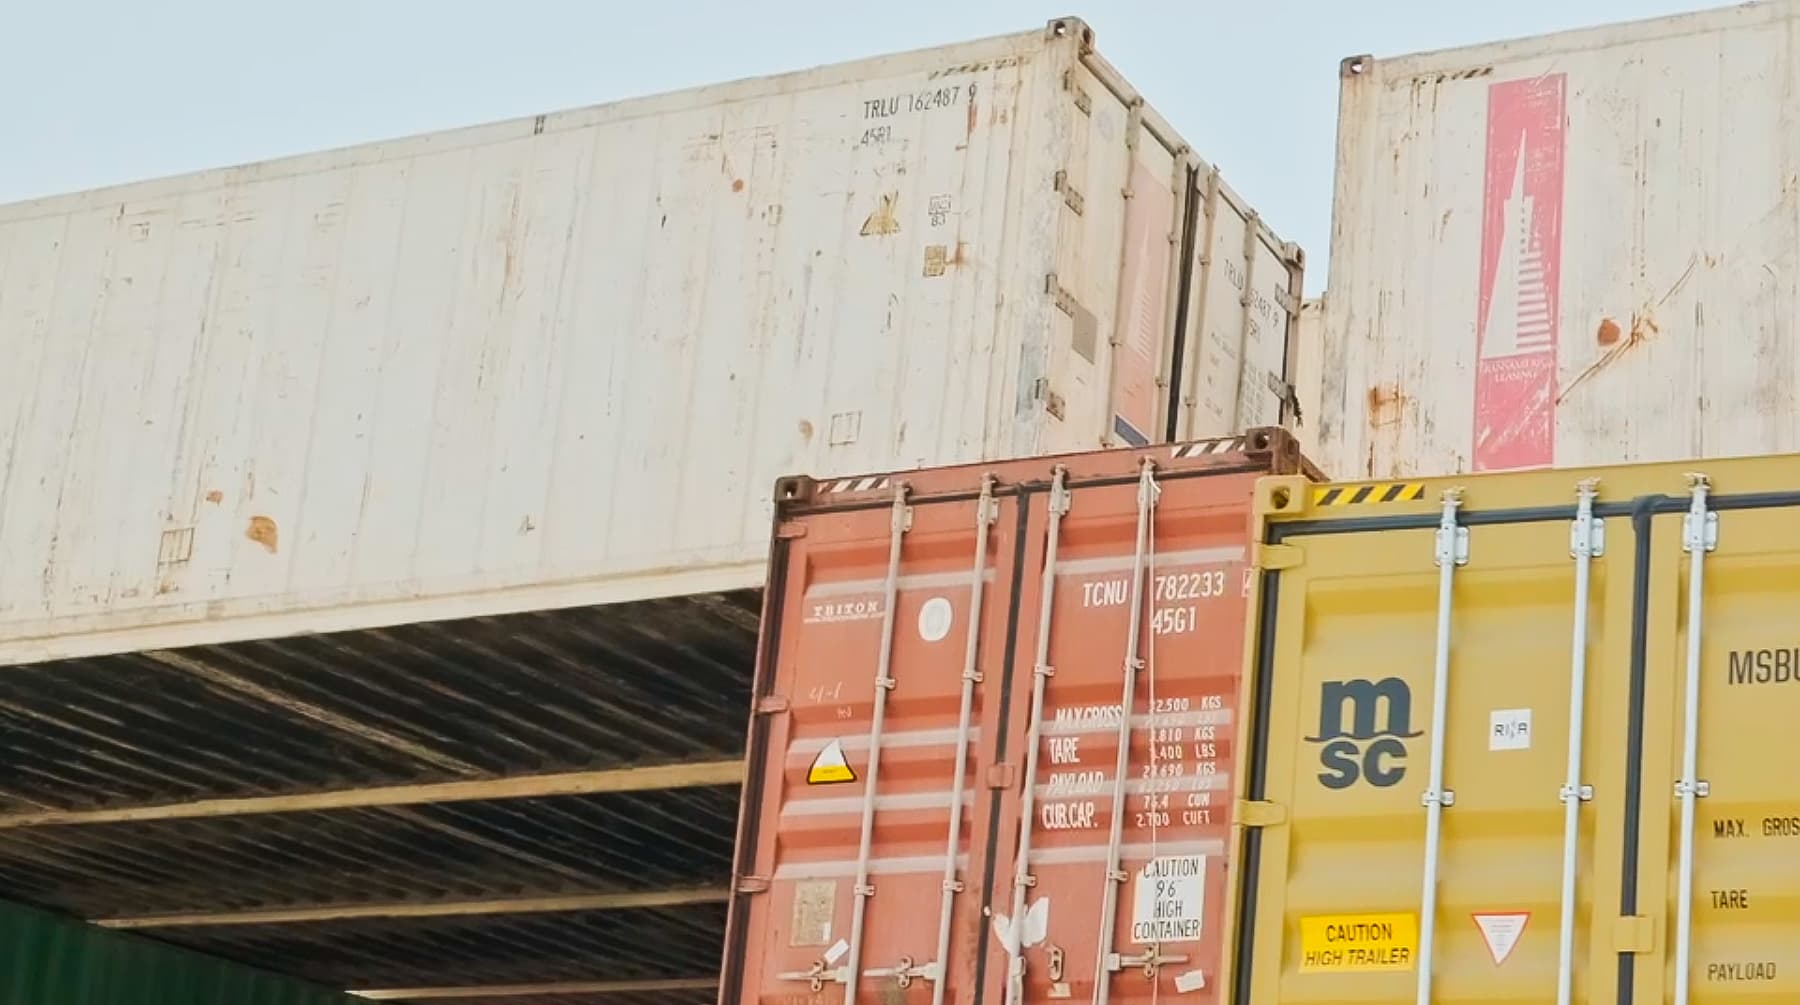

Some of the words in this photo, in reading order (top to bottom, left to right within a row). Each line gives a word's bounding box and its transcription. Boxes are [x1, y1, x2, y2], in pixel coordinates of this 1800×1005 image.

[864, 94, 899, 119] TRLU
[1083, 580, 1128, 607] TCNU
[1155, 571, 1225, 601] 782233
[813, 601, 878, 617] TRITON
[1152, 607, 1196, 634] 45G1
[1050, 738, 1080, 763] TARE
[1195, 744, 1216, 758] LBS
[1714, 817, 1750, 838] MAX.
[1153, 900, 1184, 919] HIGH
[1711, 890, 1748, 909] TARE
[1134, 919, 1200, 940] CONTAINER
[1326, 923, 1393, 943] CAUTION
[1304, 950, 1342, 967] HIGH
[1349, 947, 1411, 966] TRAILER
[1707, 962, 1777, 981] PAYLOAD
